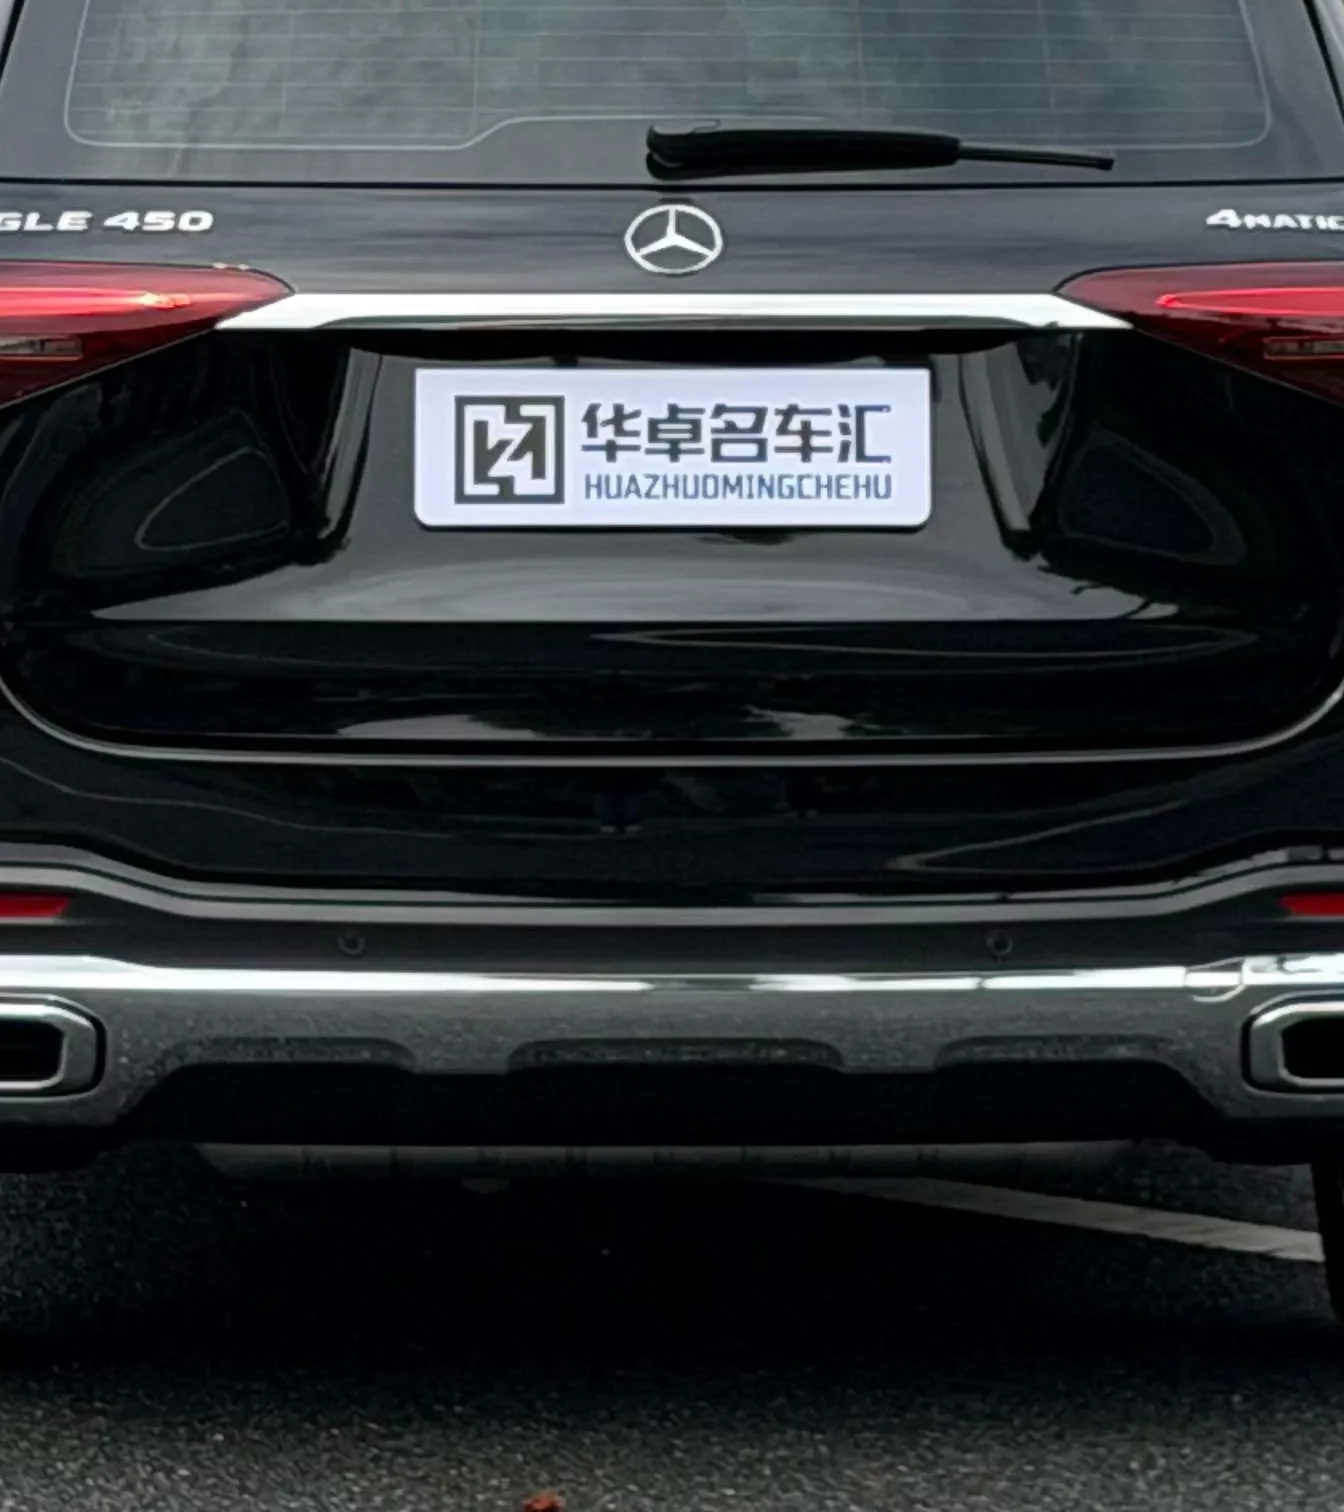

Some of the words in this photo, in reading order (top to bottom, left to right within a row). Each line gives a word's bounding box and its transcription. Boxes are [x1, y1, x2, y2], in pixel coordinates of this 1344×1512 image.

[103, 211, 214, 232] 450
[580, 403, 892, 463] 华卓名车汇
[584, 473, 892, 500] HUAZHUOMINGCHEHU
